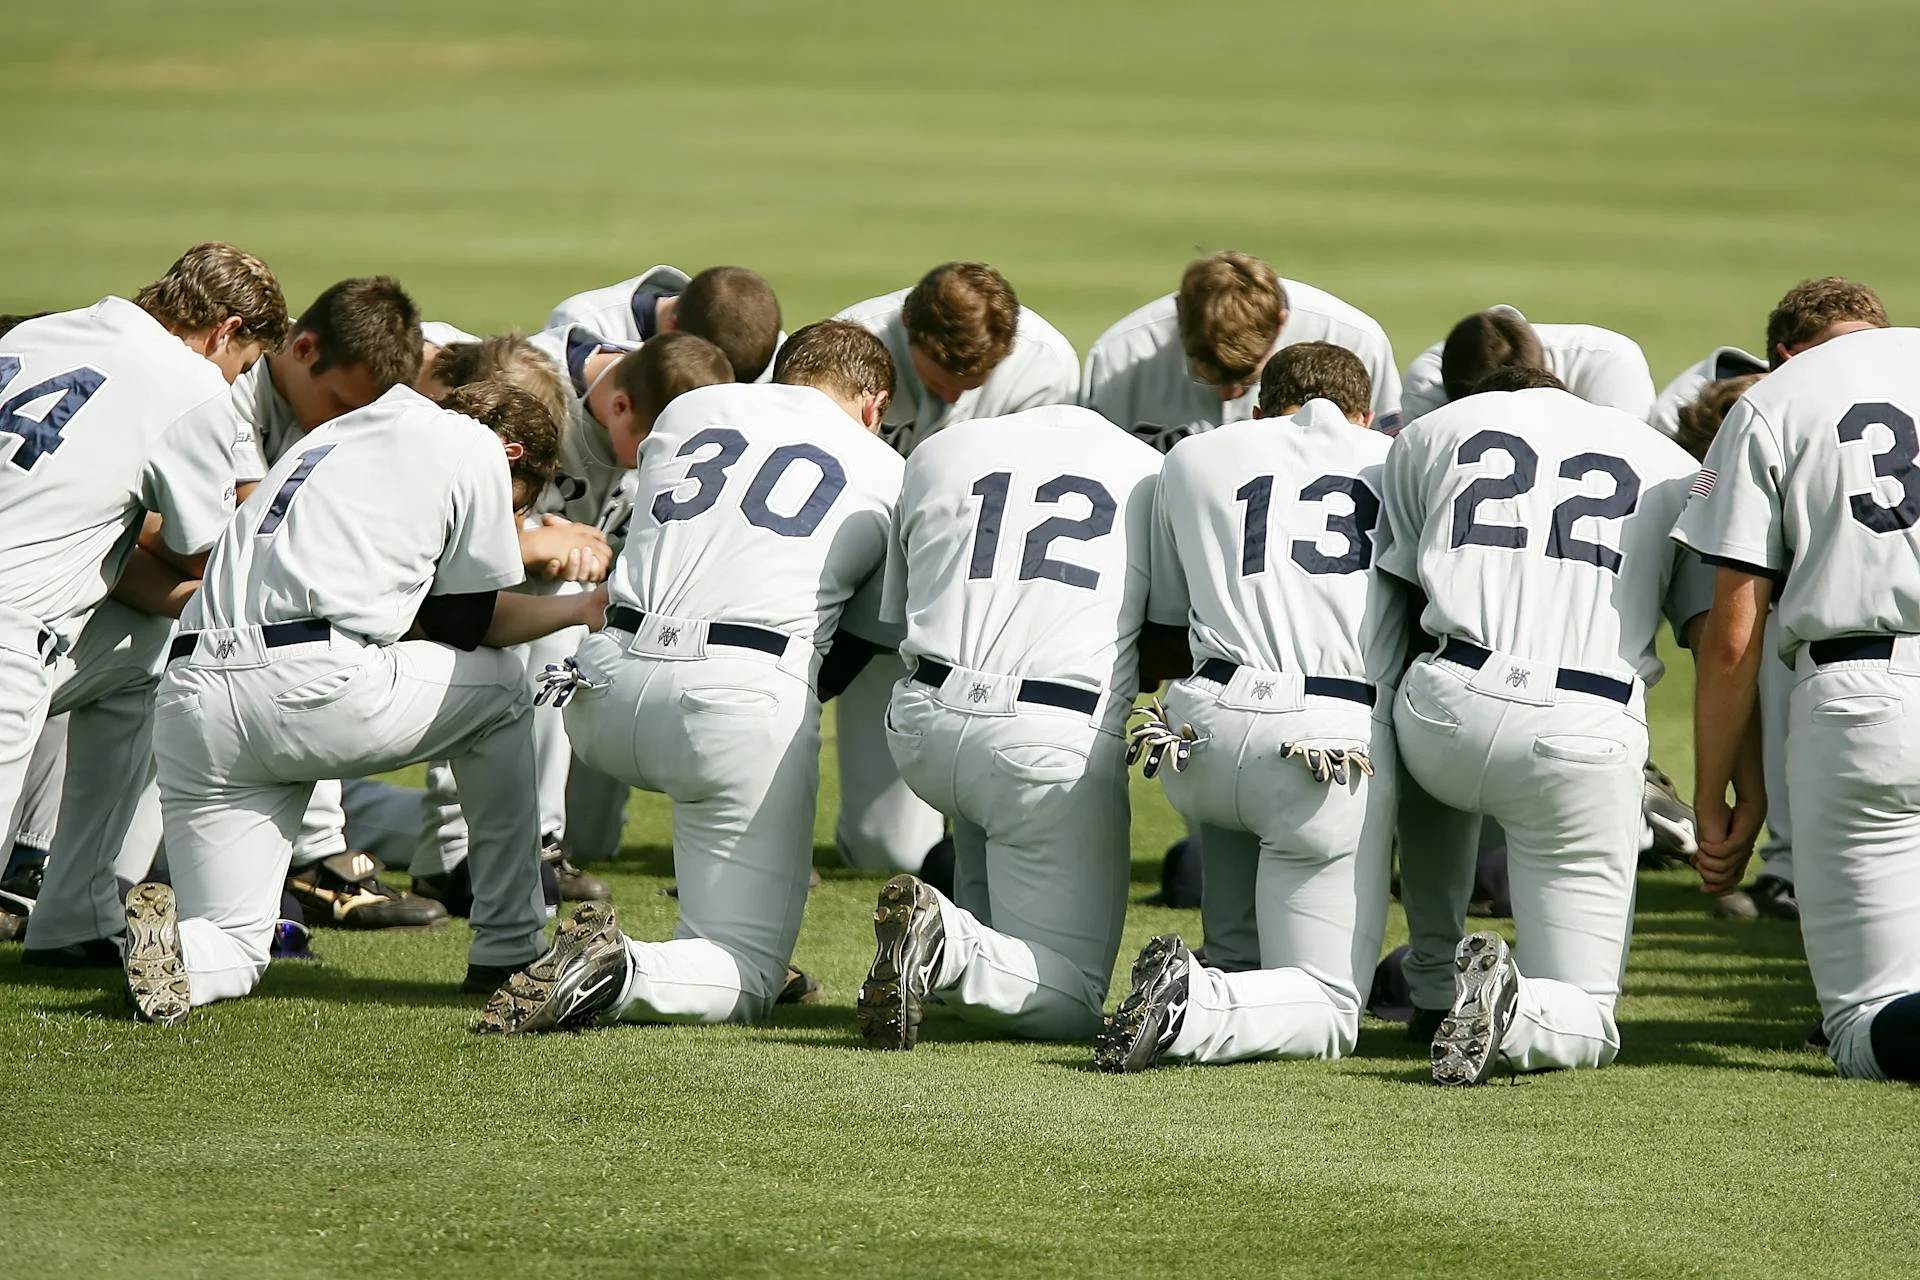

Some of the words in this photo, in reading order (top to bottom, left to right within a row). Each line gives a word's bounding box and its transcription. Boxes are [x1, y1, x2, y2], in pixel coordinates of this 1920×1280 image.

[0, 355, 109, 473] 4
[1835, 401, 1920, 534] 3
[256, 442, 339, 535] 1
[650, 426, 849, 538] 30
[968, 471, 1118, 591] 12
[1235, 474, 1381, 577] 13
[1449, 428, 1642, 576] 22
